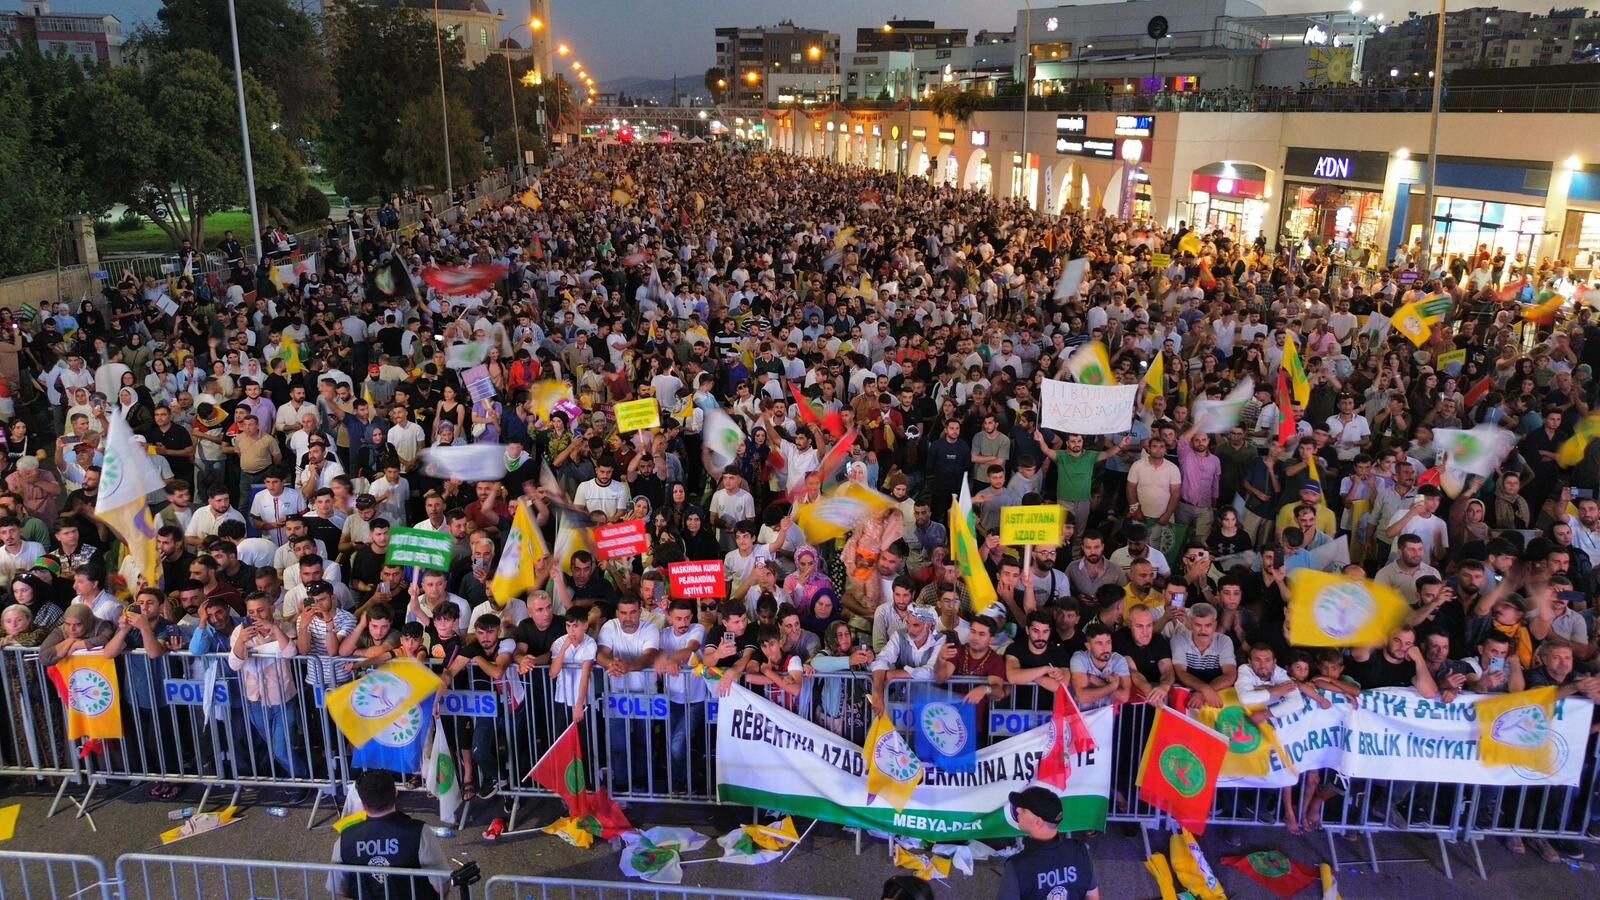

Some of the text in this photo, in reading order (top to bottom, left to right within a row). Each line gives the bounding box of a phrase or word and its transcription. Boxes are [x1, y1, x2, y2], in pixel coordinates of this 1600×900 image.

[166, 683, 228, 703] POLS
[356, 838, 399, 857] POLIS
[1037, 866, 1077, 889] POLIS
